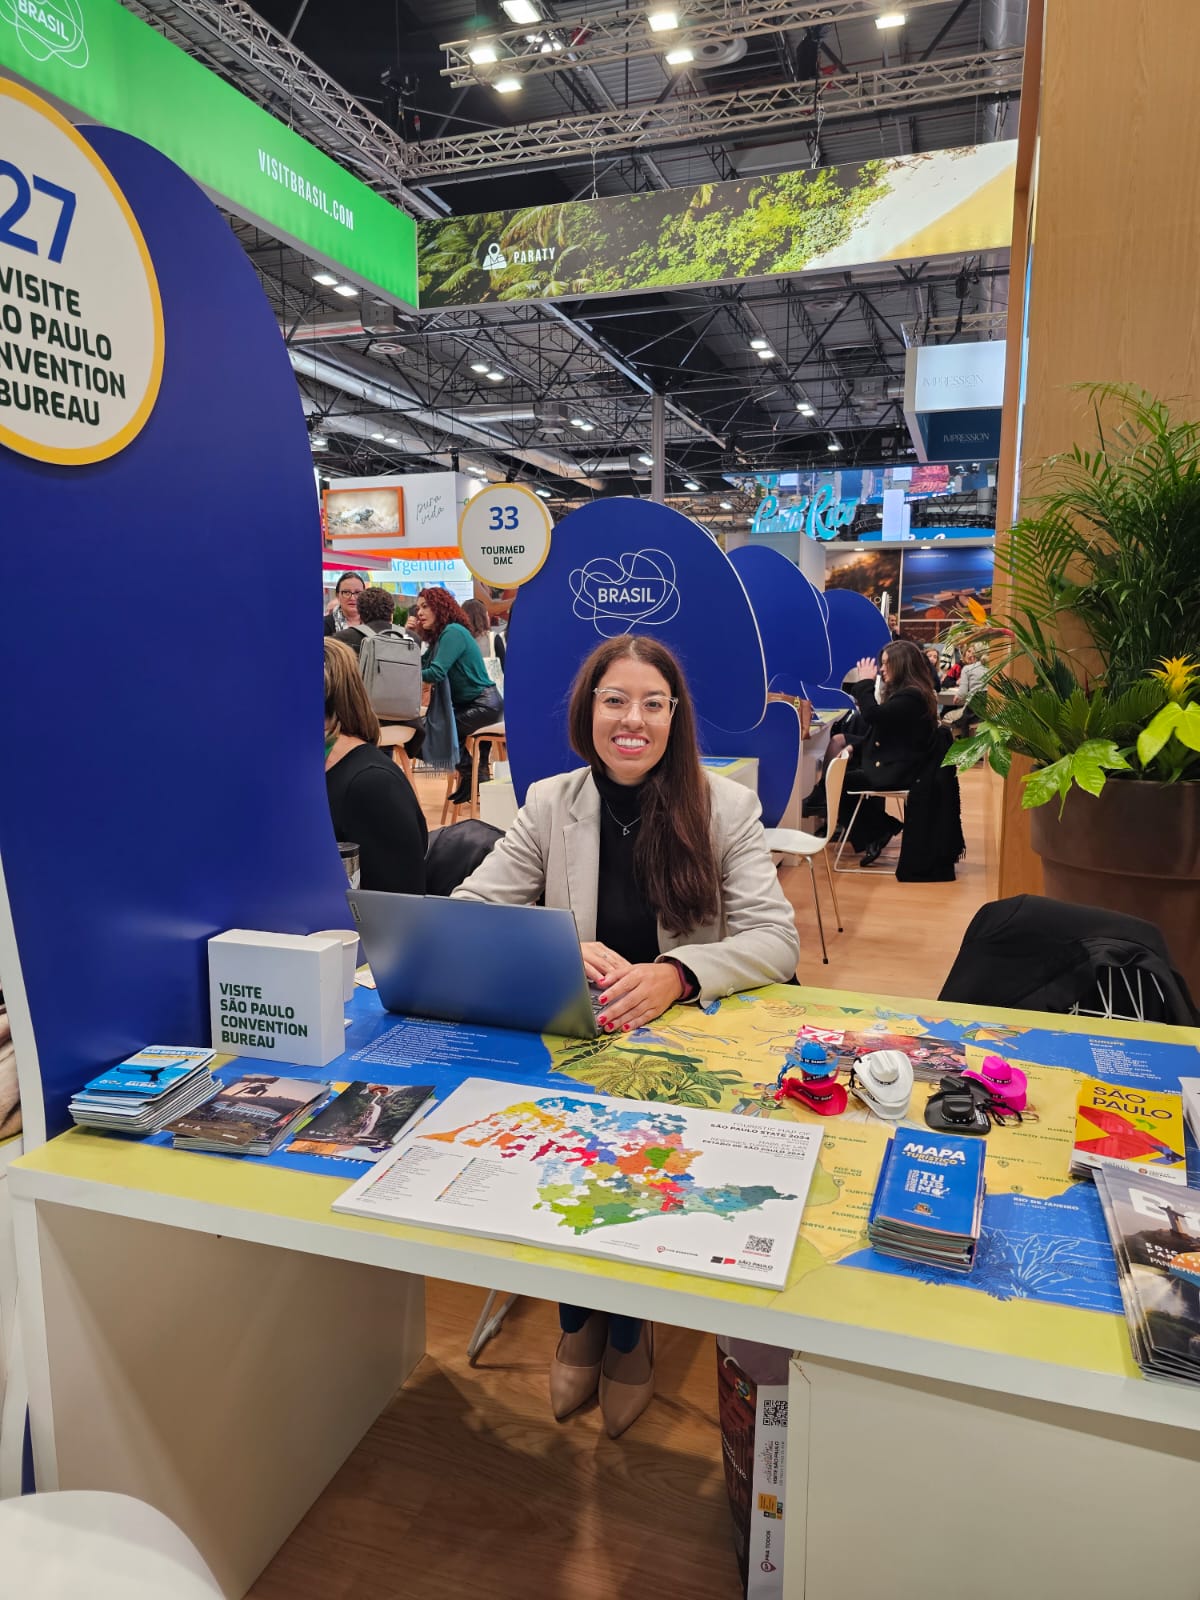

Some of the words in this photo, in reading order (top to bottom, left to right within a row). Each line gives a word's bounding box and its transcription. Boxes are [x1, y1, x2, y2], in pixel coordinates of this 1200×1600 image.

[18, 0, 70, 42] BRASIL
[258, 148, 354, 231] VISITBRASIL.COM
[513, 247, 556, 264] PARATY
[0, 266, 81, 317] VISITE
[30, 311, 112, 361] PAULO
[0, 341, 126, 399] NVENTION
[922, 374, 984, 387] IMPRESSION
[0, 378, 100, 426] BUREAU
[943, 432, 991, 442] IMPRESSION
[489, 506, 519, 530] 33
[481, 545, 525, 555] TOURMED
[493, 556, 513, 565] DMC
[598, 587, 656, 603] BRASIL
[219, 982, 262, 999] VISITE
[220, 997, 247, 1013] SÃO
[250, 1002, 295, 1019] PAULO
[221, 1014, 308, 1037] CONVENTION
[221, 1030, 275, 1048] BUREAU
[1093, 1086, 1146, 1104] SÃO
[1092, 1097, 1173, 1119] PAULO
[904, 1143, 966, 1161] MAPA
